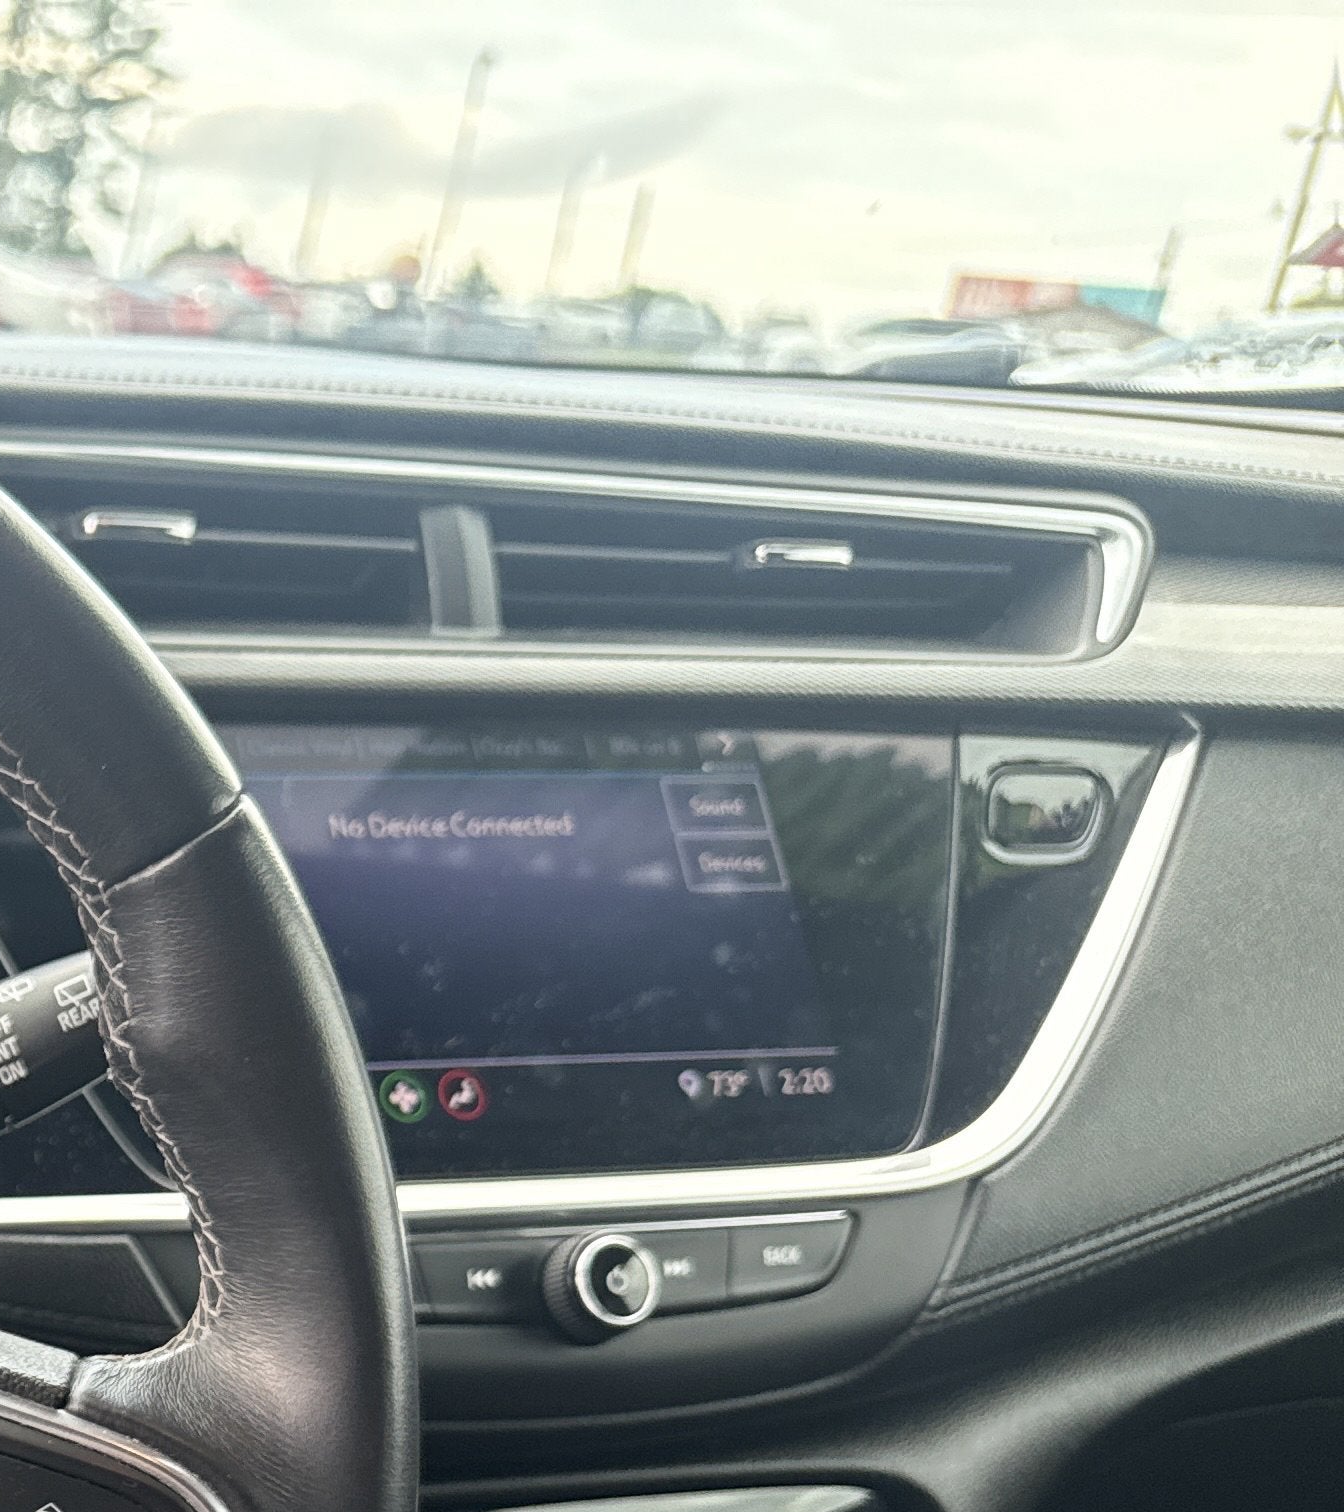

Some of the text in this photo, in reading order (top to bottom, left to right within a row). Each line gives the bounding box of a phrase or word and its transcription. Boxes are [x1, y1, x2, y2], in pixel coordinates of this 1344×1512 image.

[328, 810, 576, 839] No Device Connected
[57, 997, 100, 1032] REAR
[777, 1067, 834, 1096] 2:20
